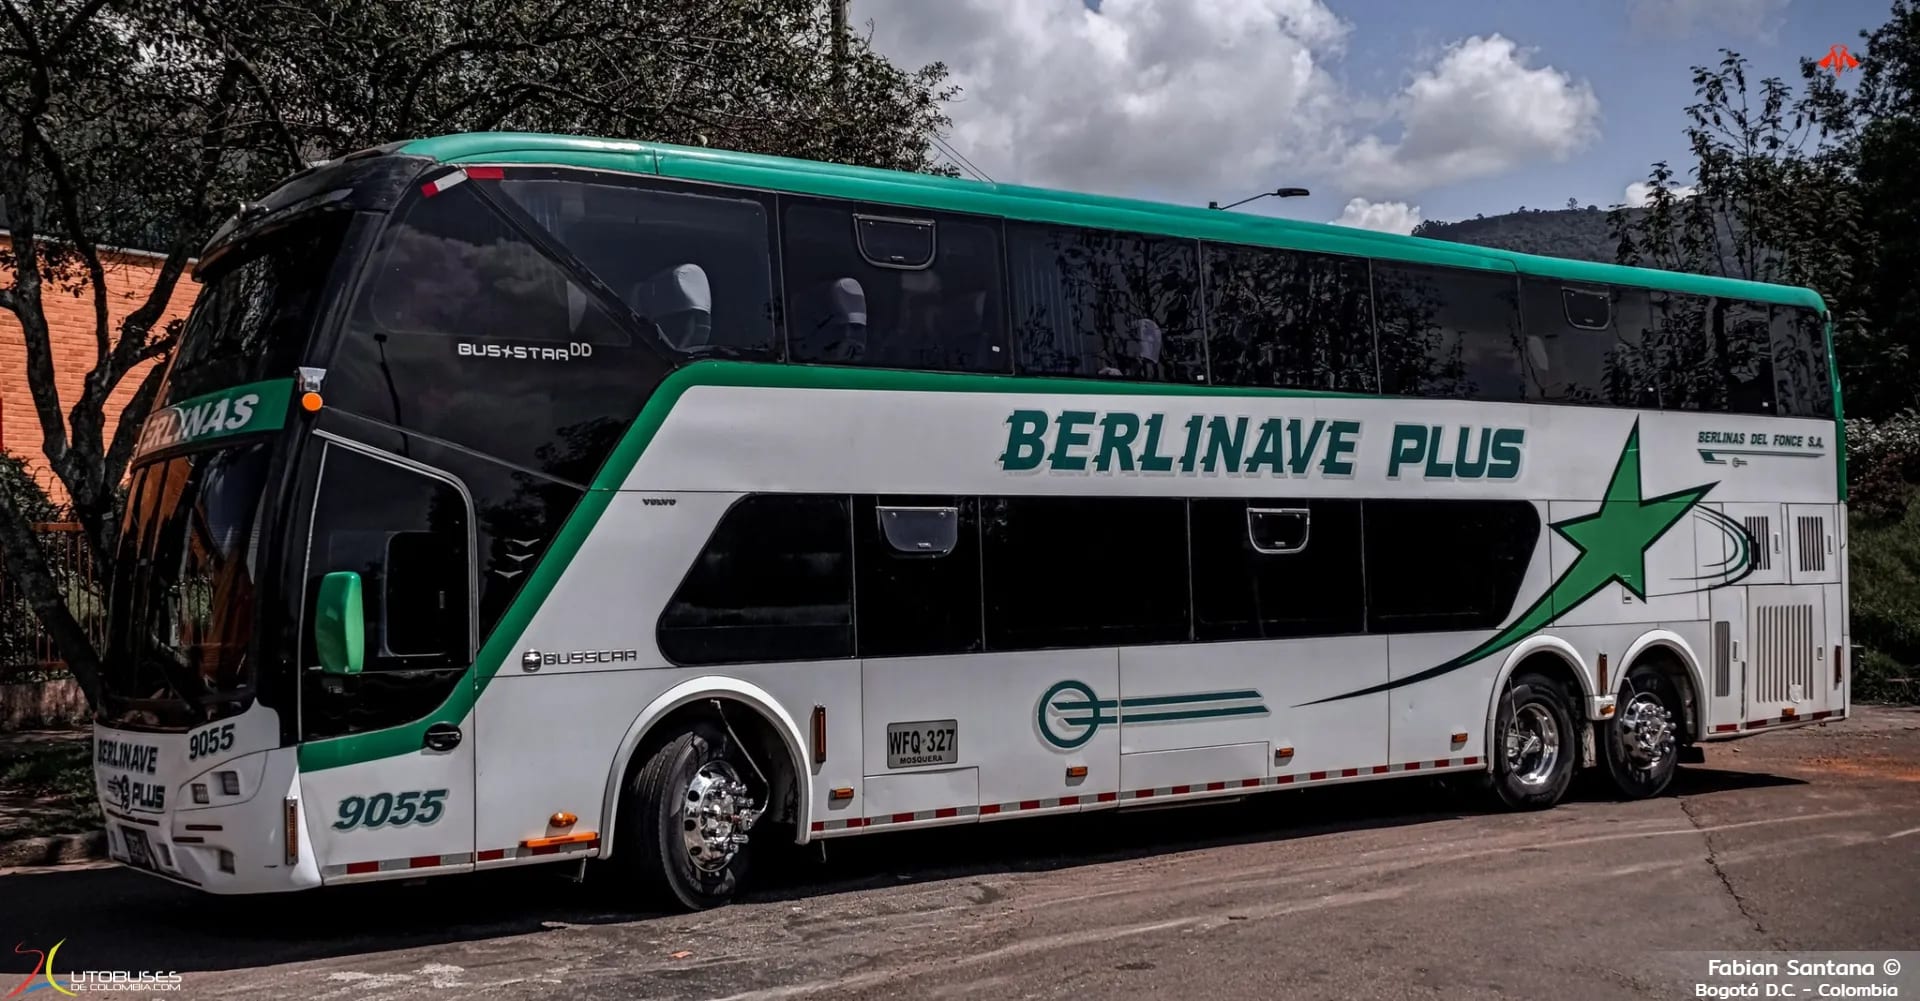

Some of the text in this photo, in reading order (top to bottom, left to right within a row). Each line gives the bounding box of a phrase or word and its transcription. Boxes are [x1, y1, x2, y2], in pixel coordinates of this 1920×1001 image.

[140, 393, 260, 451] ERLINAS
[997, 408, 1526, 480] BERLINAVE PLUS
[1698, 431, 1745, 444] BERLINAS
[1750, 433, 1769, 446] DEL
[1772, 434, 1804, 448] FONCE
[542, 649, 638, 666] BUSSCAR
[188, 723, 235, 761] 9055
[899, 754, 944, 765] MOSQUERA
[131, 781, 166, 809] PLUS
[331, 788, 449, 830] 9055
